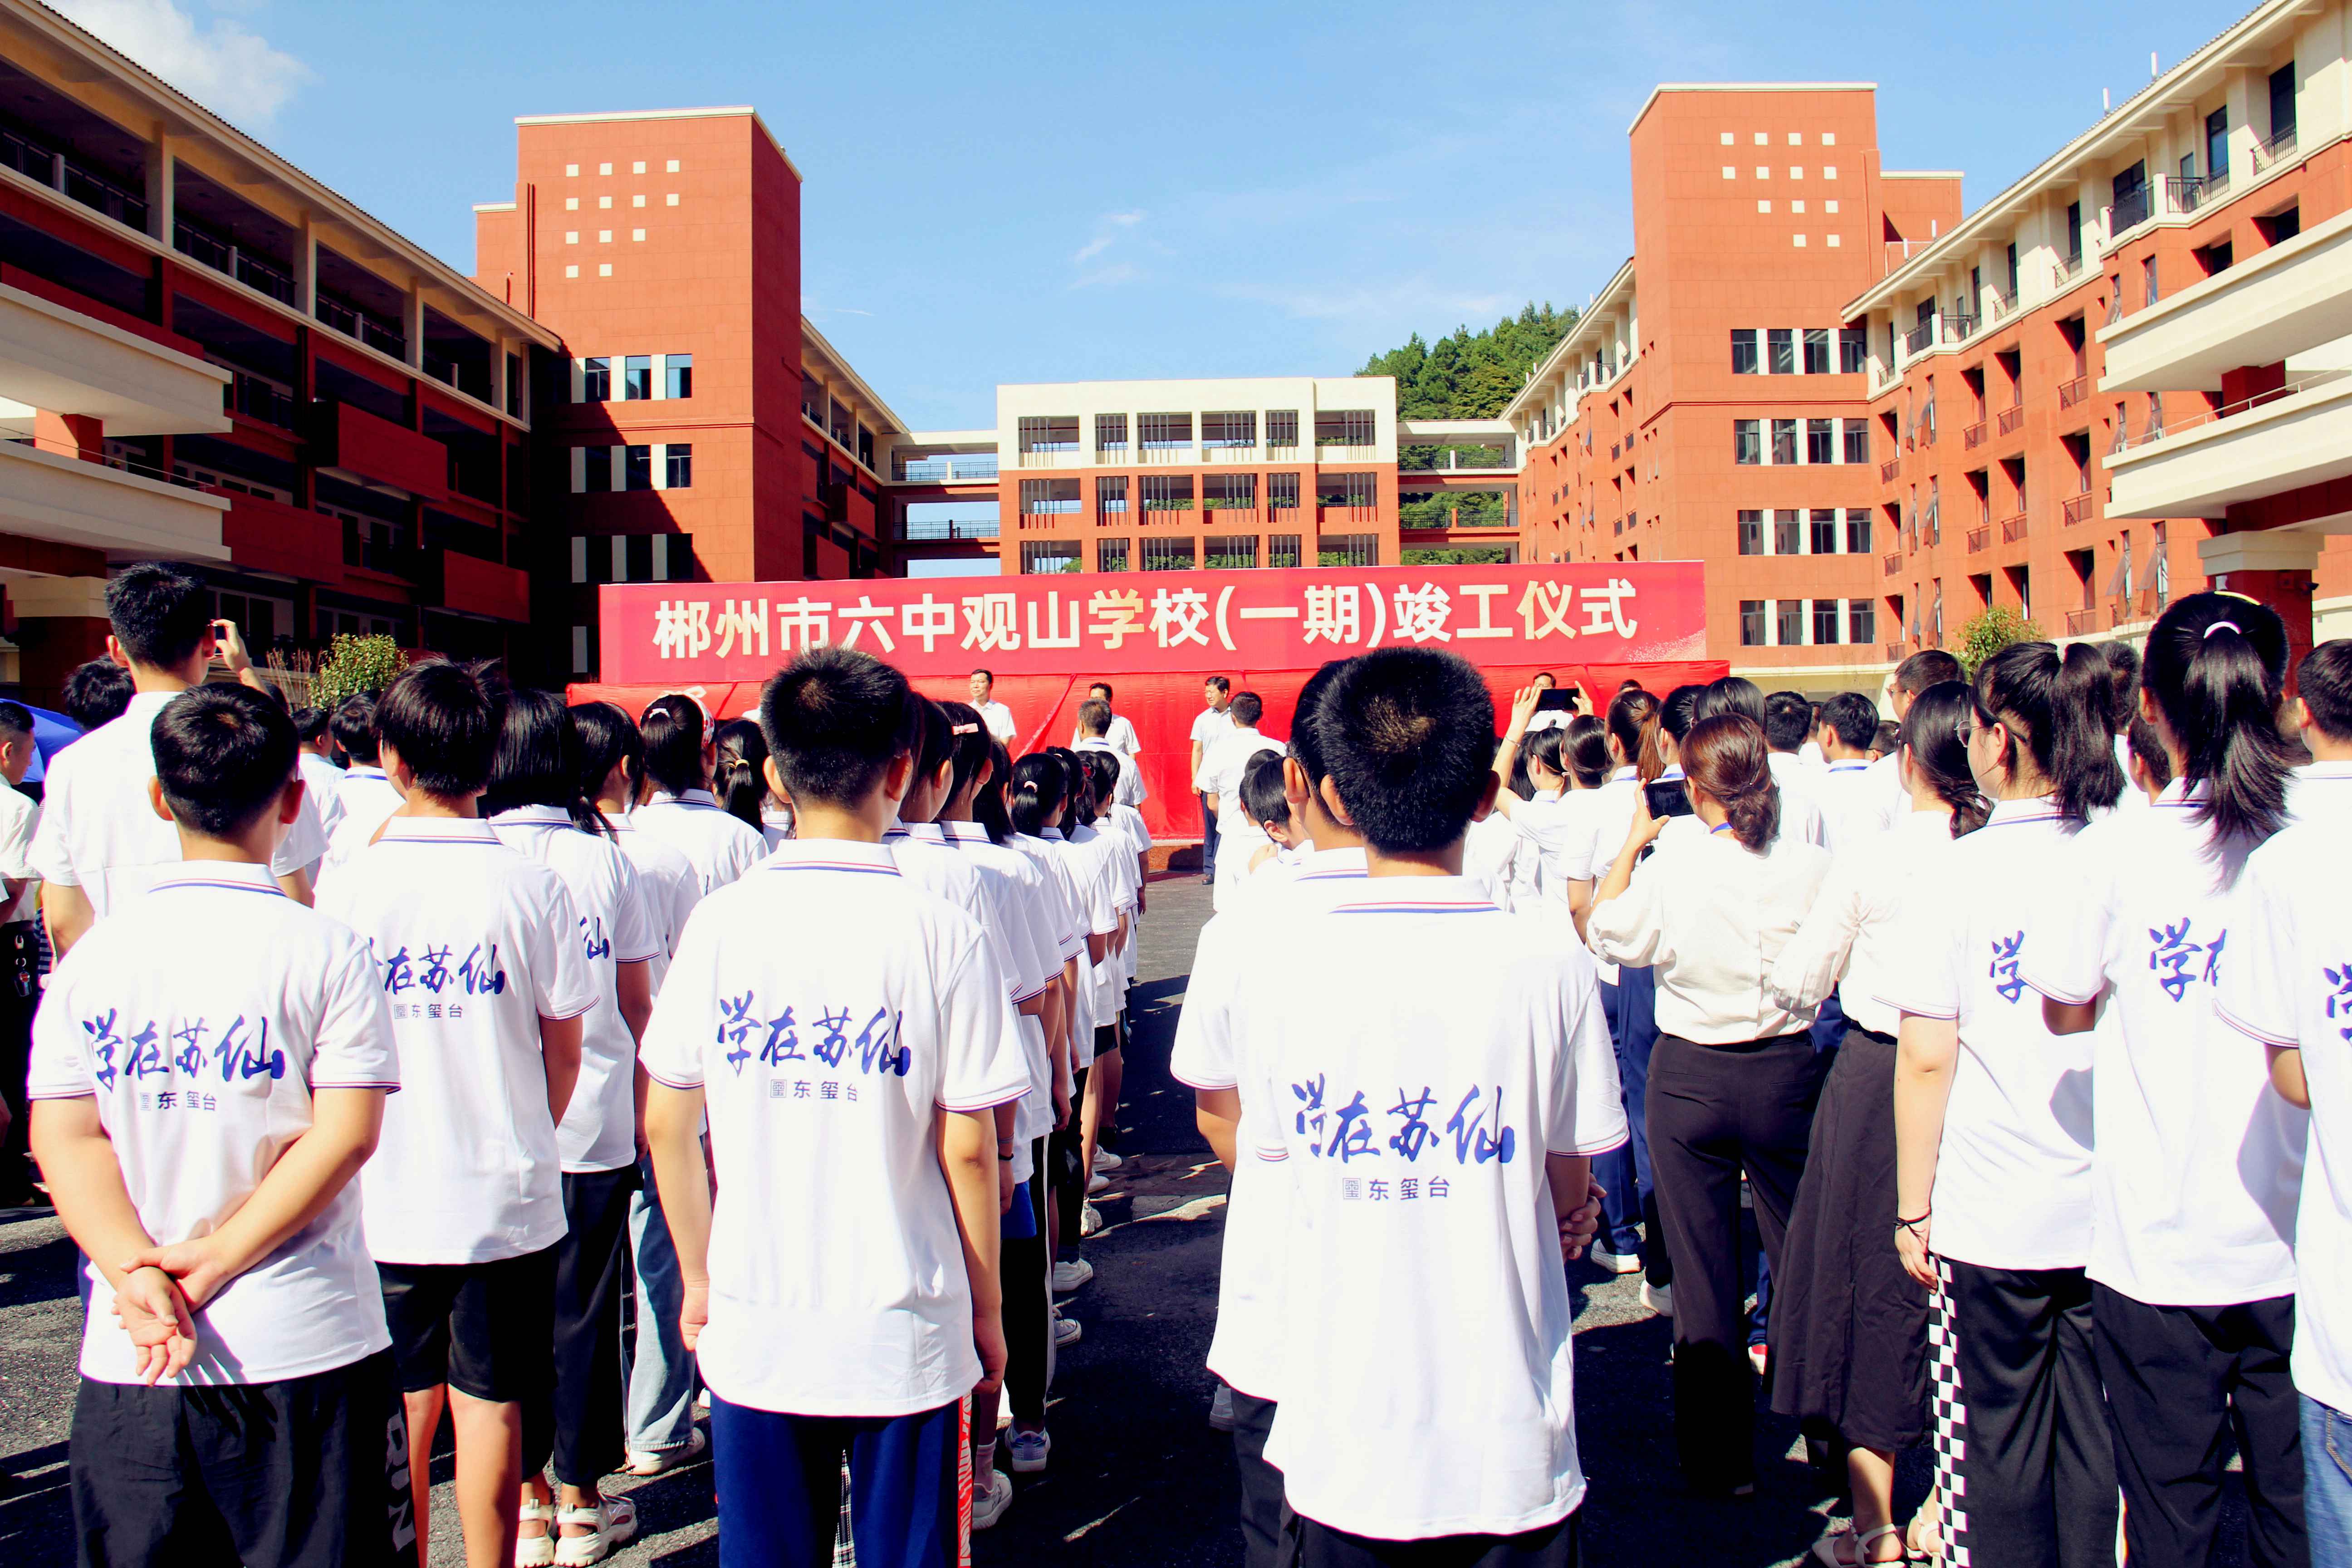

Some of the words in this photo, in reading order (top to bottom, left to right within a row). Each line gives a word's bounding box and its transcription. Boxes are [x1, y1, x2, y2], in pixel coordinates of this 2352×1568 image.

[370, 937, 506, 995] 在苏仙
[82, 1007, 286, 1093] 学在苏仙
[717, 990, 911, 1078] 学在苏仙
[1291, 1073, 1516, 1165] 学在苏仙
